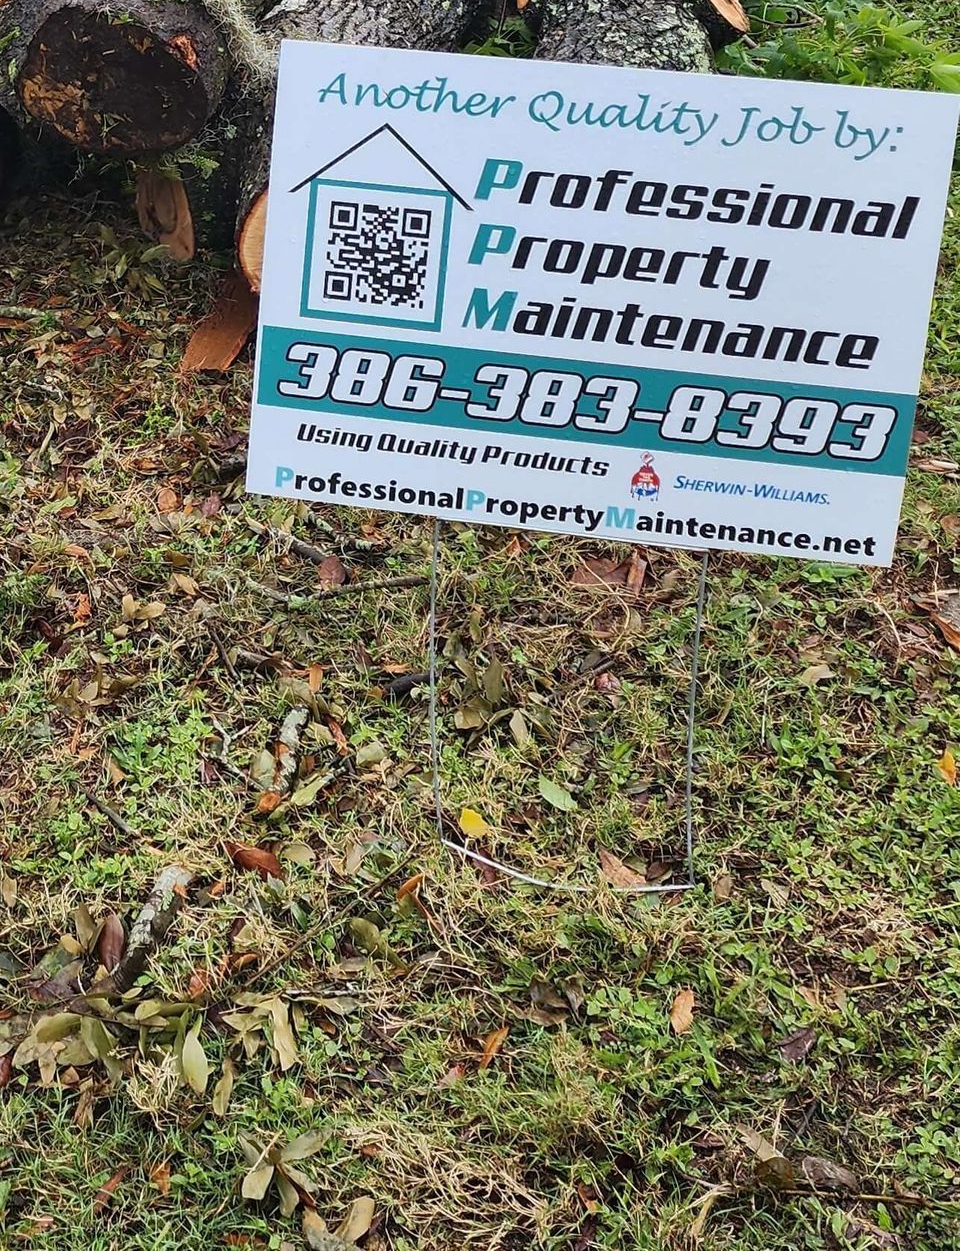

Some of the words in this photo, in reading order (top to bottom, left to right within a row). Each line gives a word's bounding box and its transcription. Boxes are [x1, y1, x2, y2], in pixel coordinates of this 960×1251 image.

[318, 72, 516, 118] Another
[528, 90, 719, 146] Quality
[721, 105, 824, 147] Job
[834, 109, 904, 161] by:
[473, 157, 920, 239] Professional
[467, 223, 770, 300] Property
[461, 287, 880, 369] Maintenance
[276, 341, 897, 463] 386-383-8393
[296, 423, 373, 452] Using
[376, 434, 477, 464] Quality
[481, 445, 610, 476] Products
[275, 466, 876, 556] ProfessionalPropertyMaintenance.net
